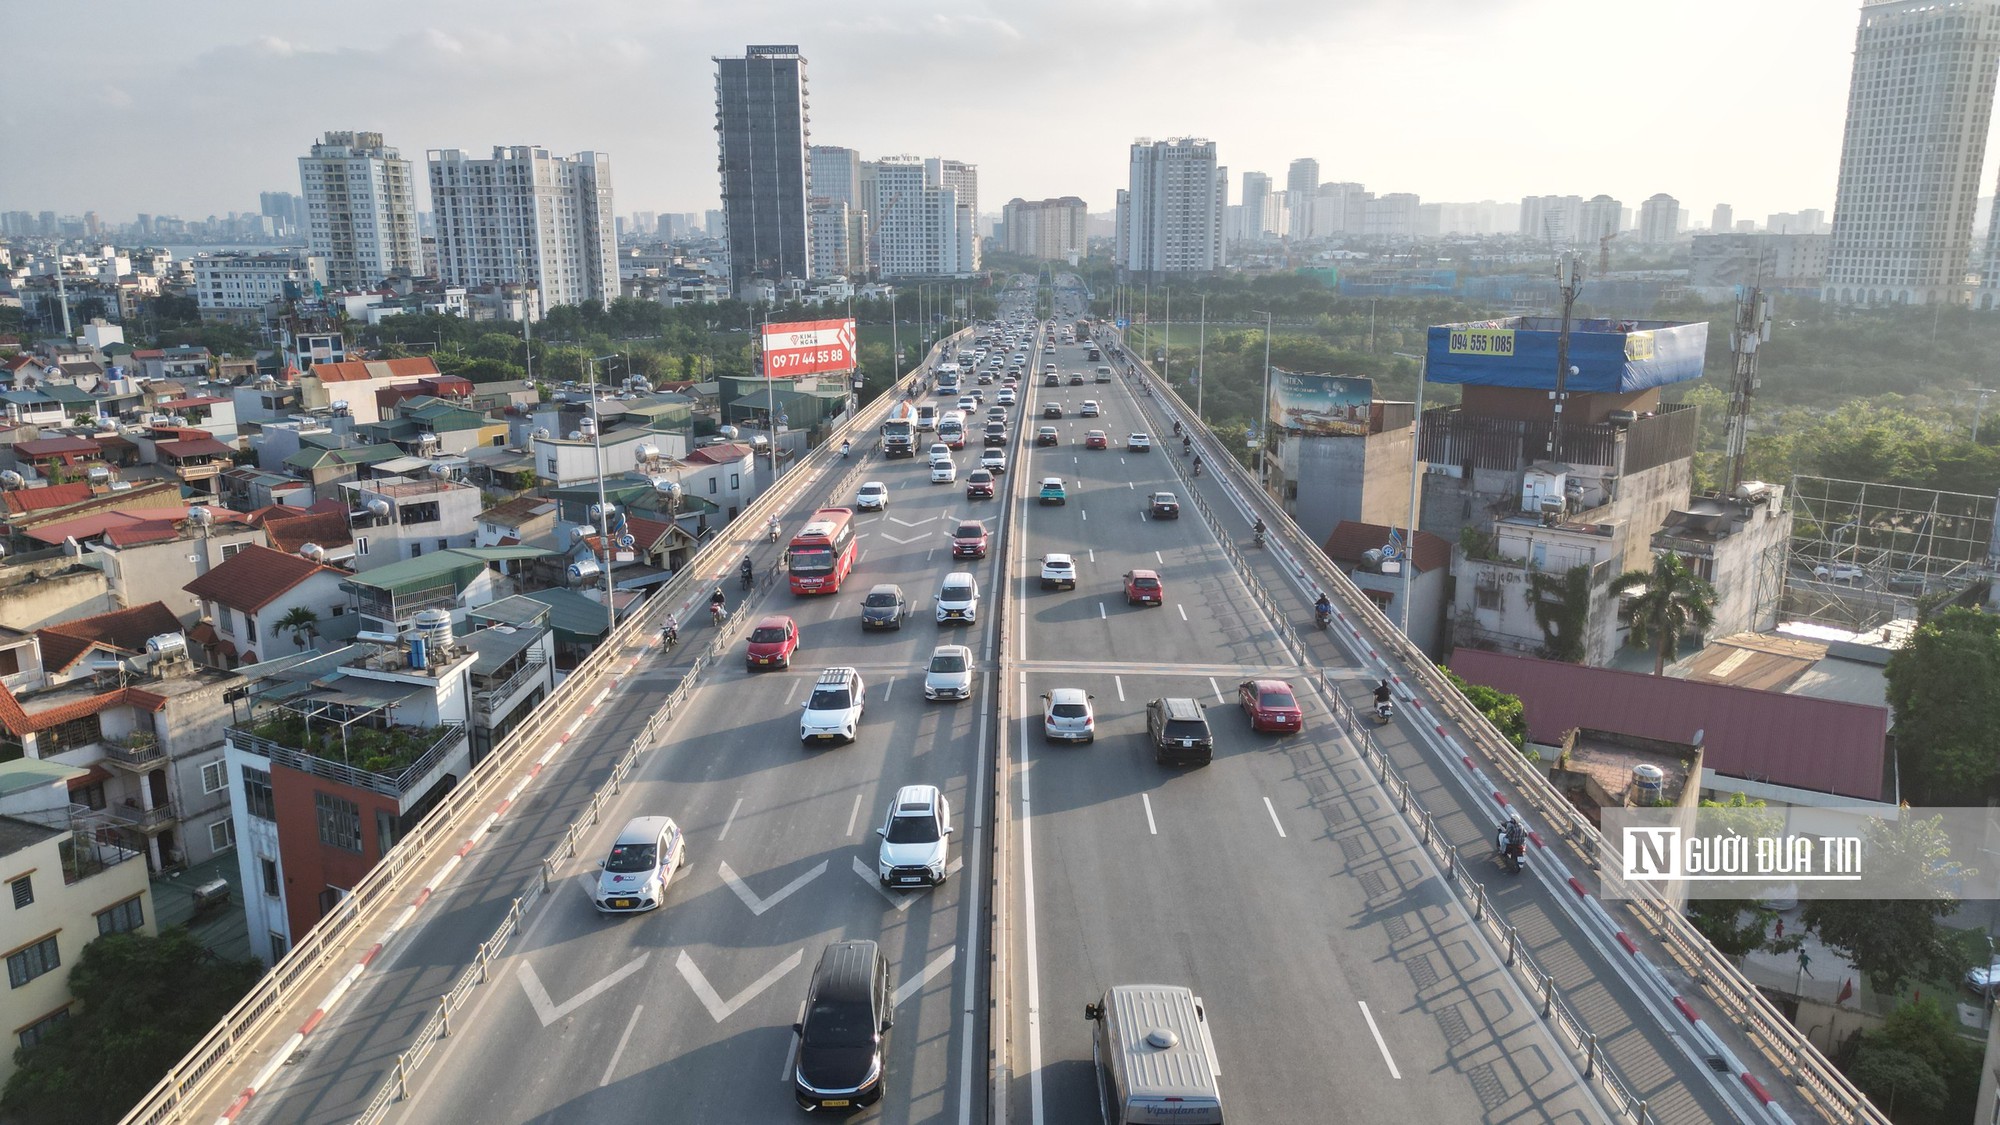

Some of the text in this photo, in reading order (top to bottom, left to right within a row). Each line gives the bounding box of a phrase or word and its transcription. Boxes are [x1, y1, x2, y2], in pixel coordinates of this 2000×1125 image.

[747, 46, 797, 54] PentStudio
[1452, 334, 1512, 352] 094 555 1085
[773, 349, 843, 368] 09 77 44 55 88
